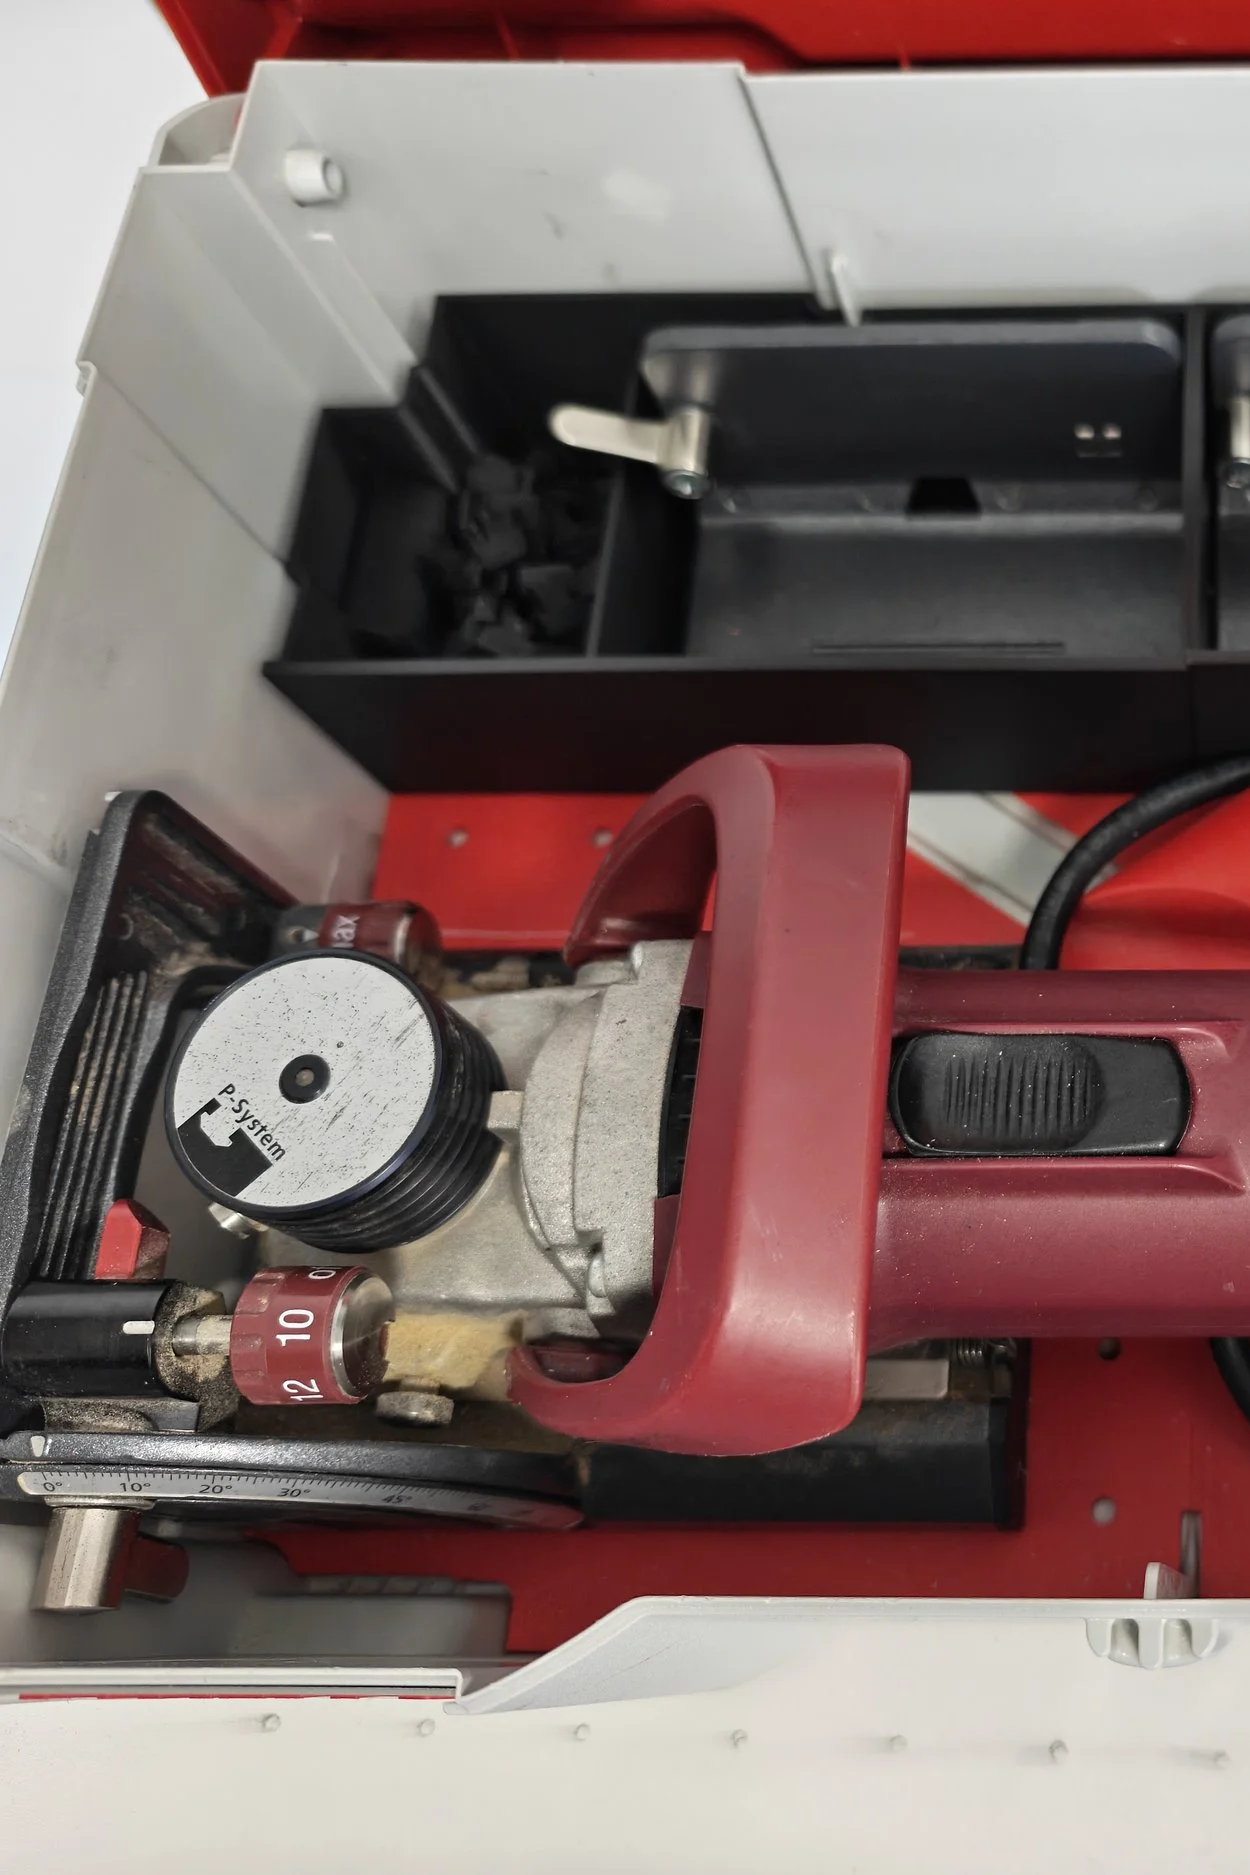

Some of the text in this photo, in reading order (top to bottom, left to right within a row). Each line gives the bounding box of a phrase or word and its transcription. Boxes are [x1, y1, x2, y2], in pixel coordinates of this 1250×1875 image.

[331, 914, 360, 948] ax
[218, 1083, 286, 1161] P-System
[275, 1308, 315, 1347] 10
[282, 1378, 324, 1402] 12
[119, 1482, 151, 1492] 10°
[199, 1484, 233, 1494] 20°
[277, 1487, 311, 1498] 30°
